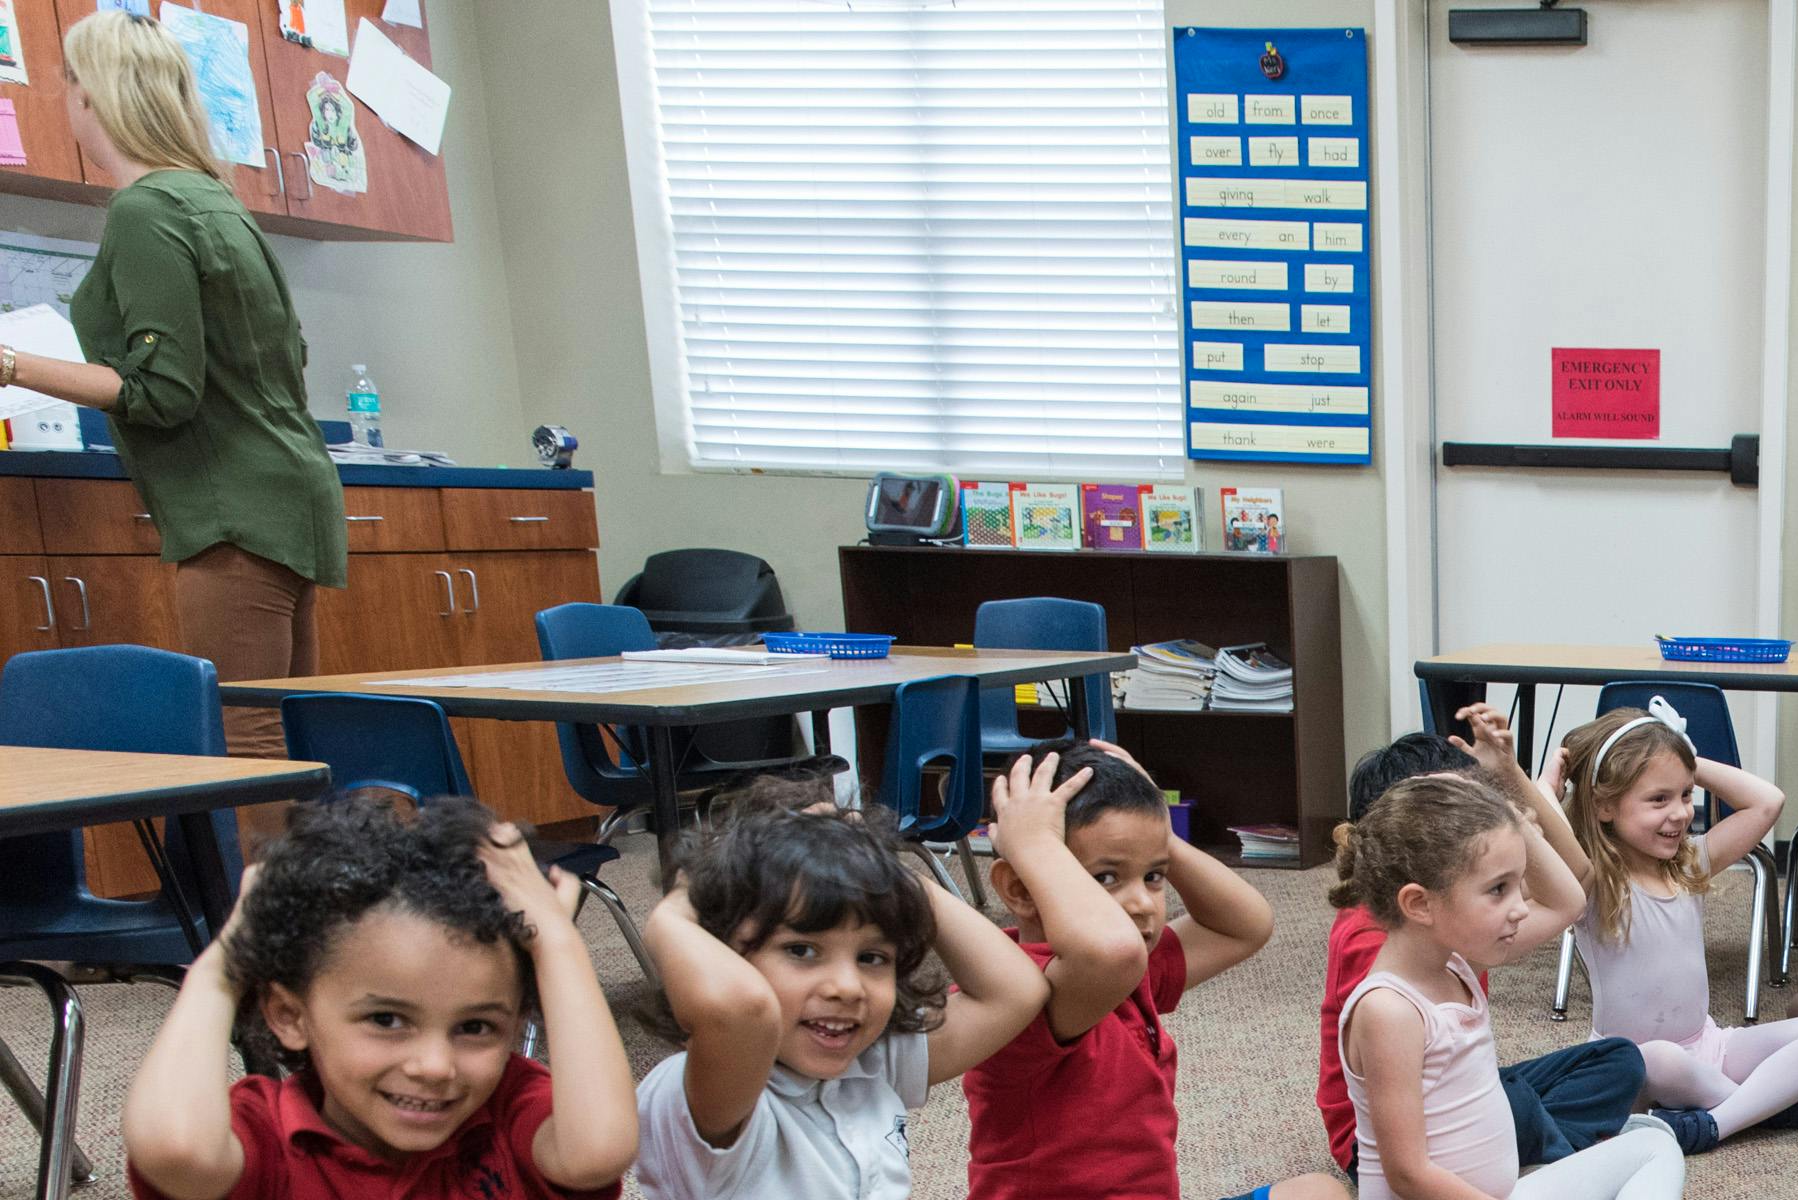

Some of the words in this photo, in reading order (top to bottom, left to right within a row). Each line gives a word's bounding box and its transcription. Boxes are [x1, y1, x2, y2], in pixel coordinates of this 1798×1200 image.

[1206, 103, 1225, 119] old
[1252, 101, 1283, 117] from
[1310, 107, 1340, 120] once
[1205, 147, 1232, 159] over
[1268, 142, 1284, 165] fly
[1324, 145, 1348, 162] had
[1219, 187, 1254, 207] giving
[1303, 188, 1332, 204] walk
[1218, 230, 1252, 247] every
[1278, 231, 1295, 242] an
[1325, 230, 1347, 246] him
[1220, 269, 1257, 284] round
[1324, 270, 1339, 289] by
[1228, 309, 1255, 326] then
[1316, 311, 1330, 327] let
[1207, 351, 1226, 368] put
[1300, 353, 1325, 370] stop
[1561, 360, 1650, 374] EMERGENCY
[1568, 378, 1602, 390] EXIT
[1604, 379, 1643, 392] ONLY
[1223, 391, 1257, 409] again
[1308, 393, 1331, 411] just
[1557, 411, 1591, 421] ALARM
[1594, 412, 1618, 422] WILL
[1620, 412, 1655, 423] SOUND
[1223, 431, 1256, 446] thank
[1307, 437, 1335, 449] were
